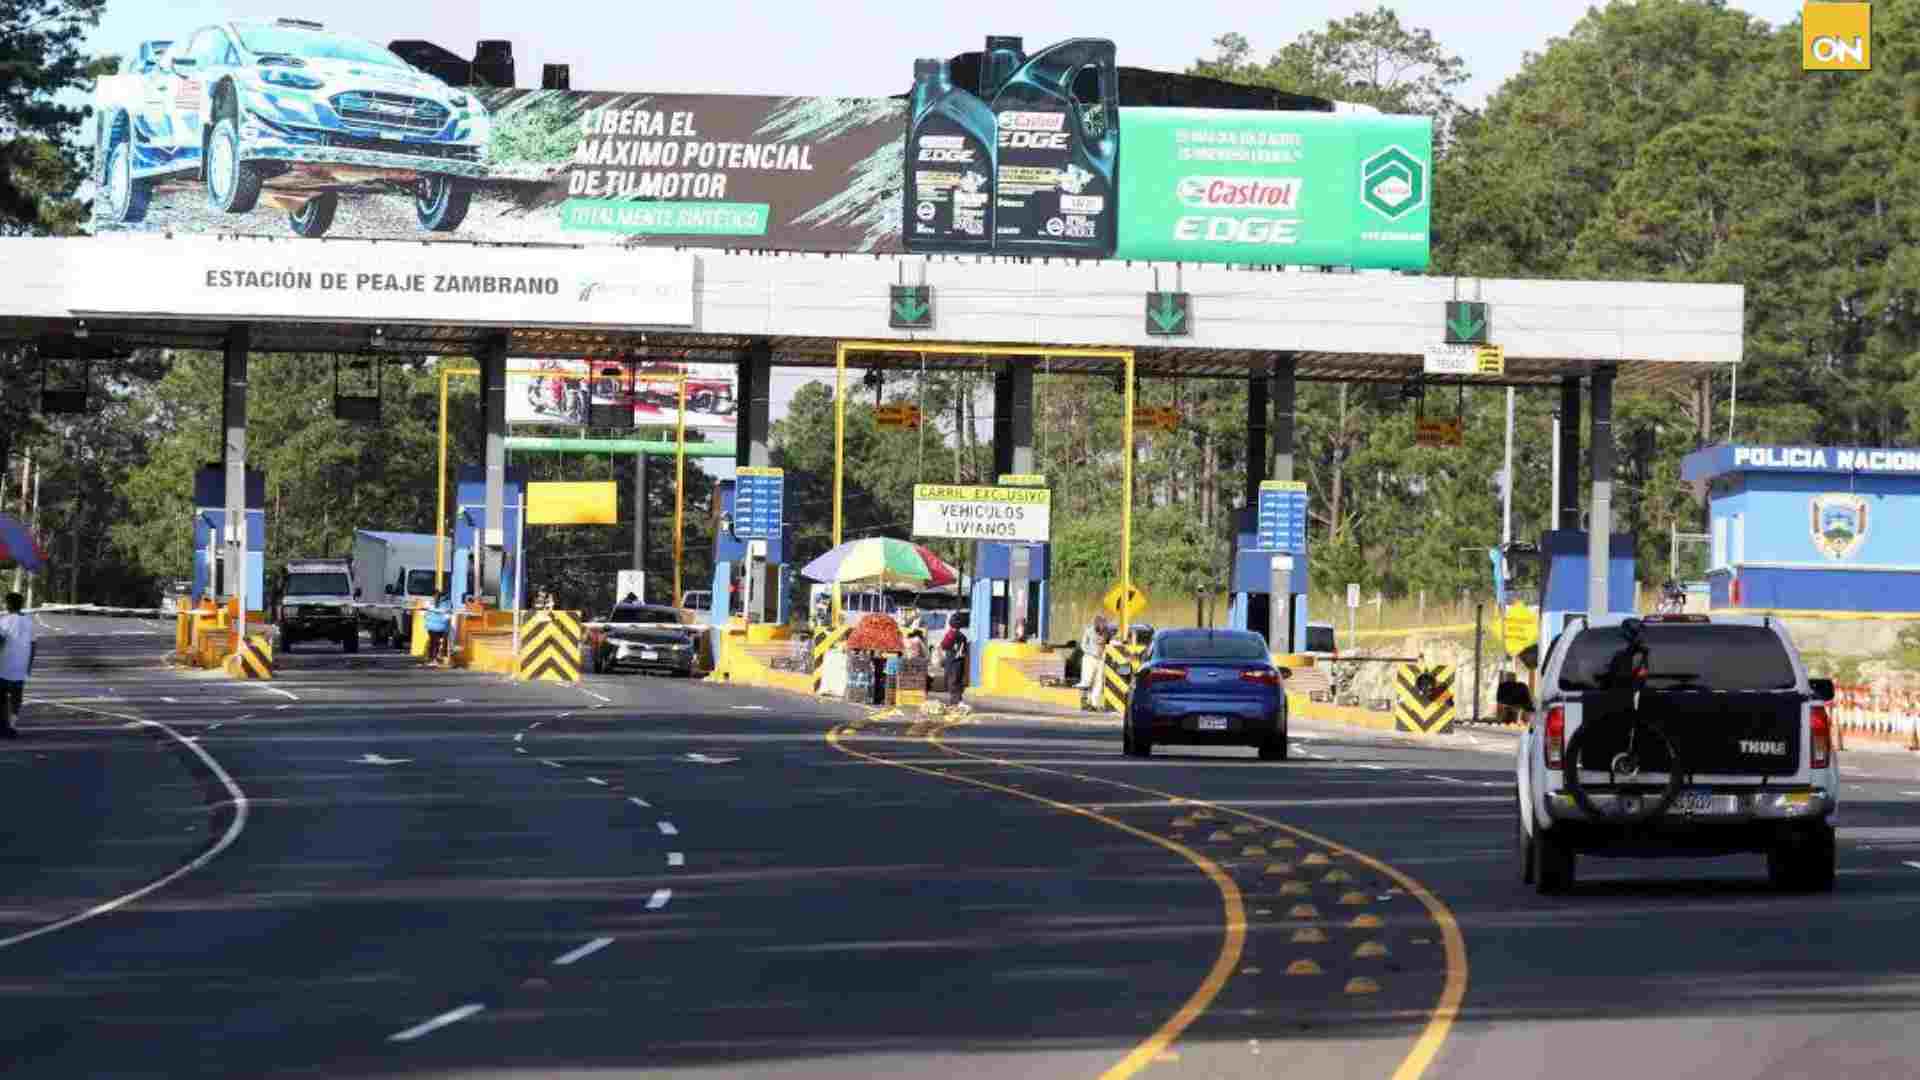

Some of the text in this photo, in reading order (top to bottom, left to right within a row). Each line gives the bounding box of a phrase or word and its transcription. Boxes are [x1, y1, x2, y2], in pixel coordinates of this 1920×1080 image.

[582, 110, 696, 136] LIBERA EL
[573, 137, 813, 170] MÁXIMO POTENCIAL
[569, 170, 727, 198] DE TU MOTOR
[1208, 180, 1291, 206] Castrol
[1174, 218, 1299, 244] EDGE
[206, 267, 559, 296] ESTACIÓN DE PEAJE ZAMBRANO
[1734, 447, 1825, 468] POLICIA
[919, 485, 1047, 502] CARRIL EXCLUSIVO
[941, 504, 1025, 520] VEHICULOS
[946, 522, 1016, 536] LIVIANOS
[1738, 740, 1786, 755] THULE
